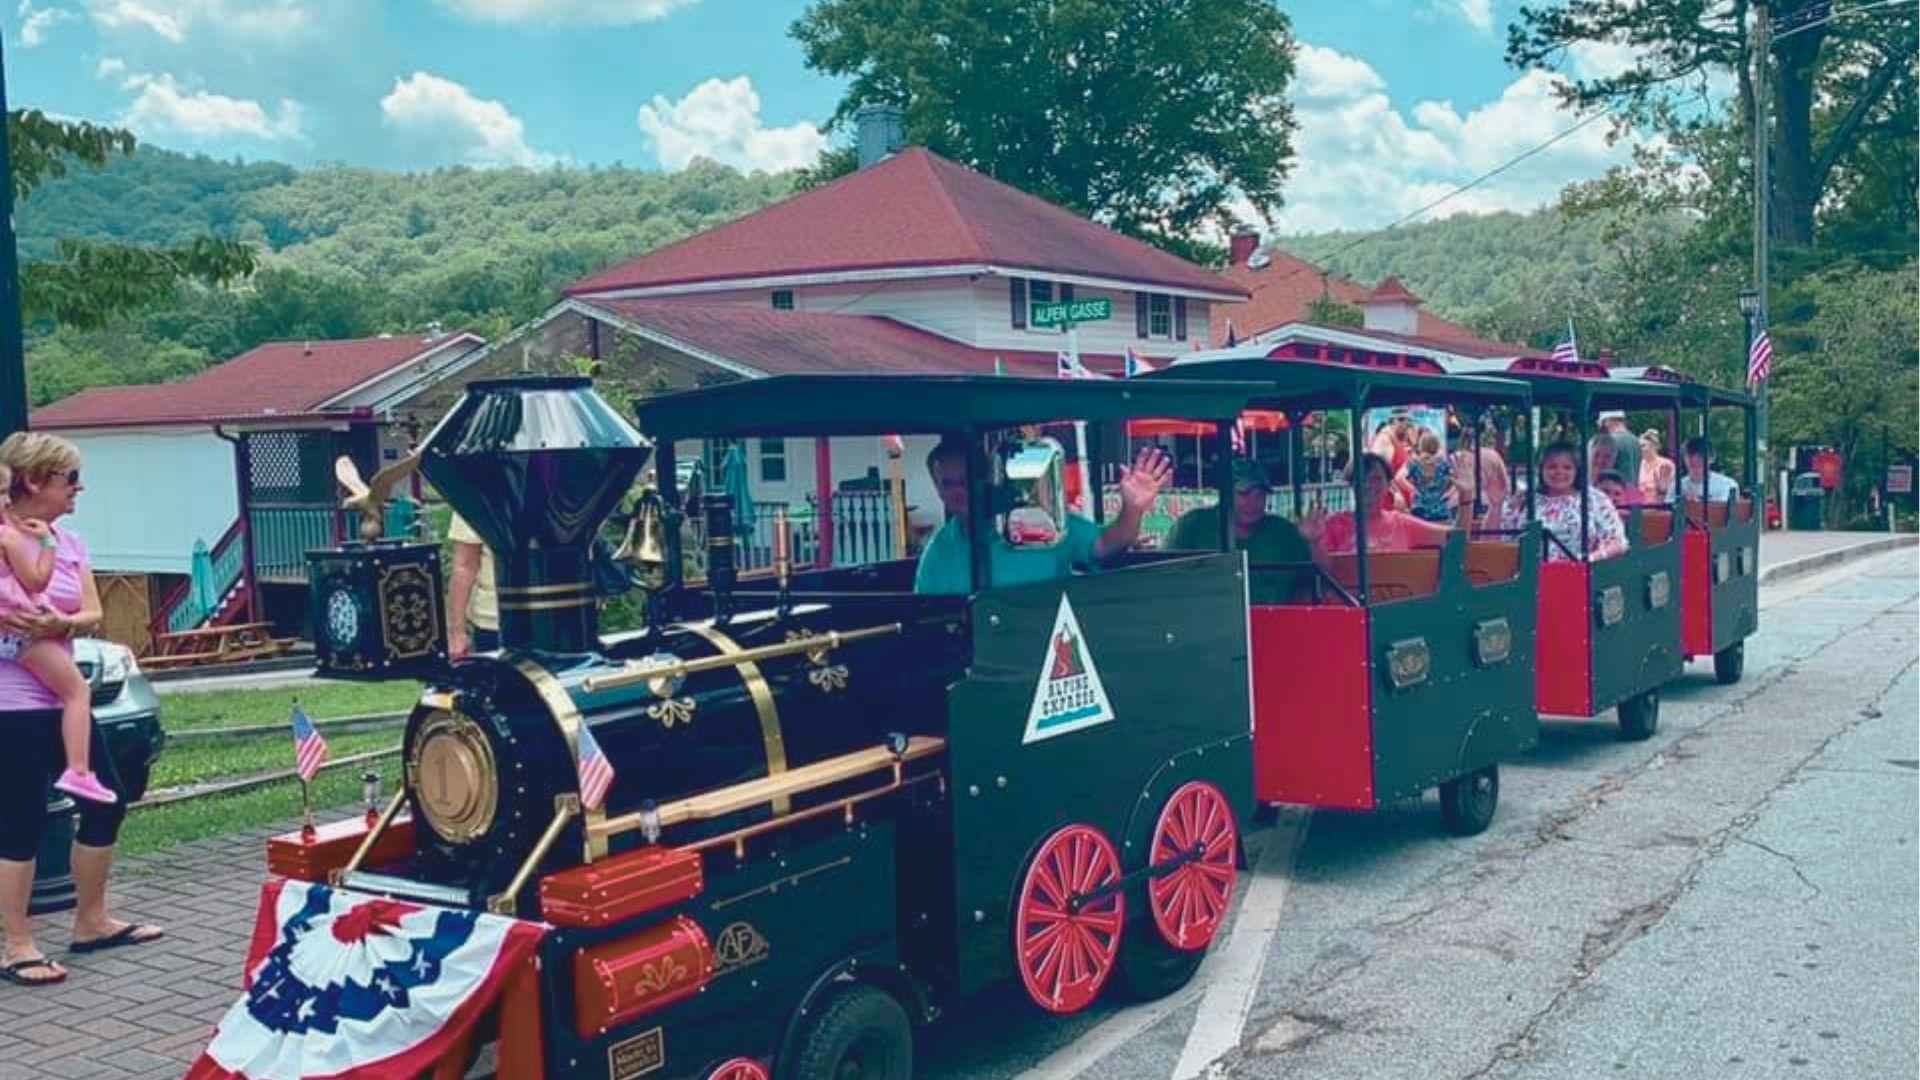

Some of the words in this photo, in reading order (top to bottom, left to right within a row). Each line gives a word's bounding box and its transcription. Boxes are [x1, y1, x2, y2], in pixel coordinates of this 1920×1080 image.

[1034, 305, 1067, 323] ALPEN
[1069, 301, 1107, 319] GASSE
[1048, 675, 1089, 699] ALPINE
[1042, 689, 1095, 717] EXPRESS
